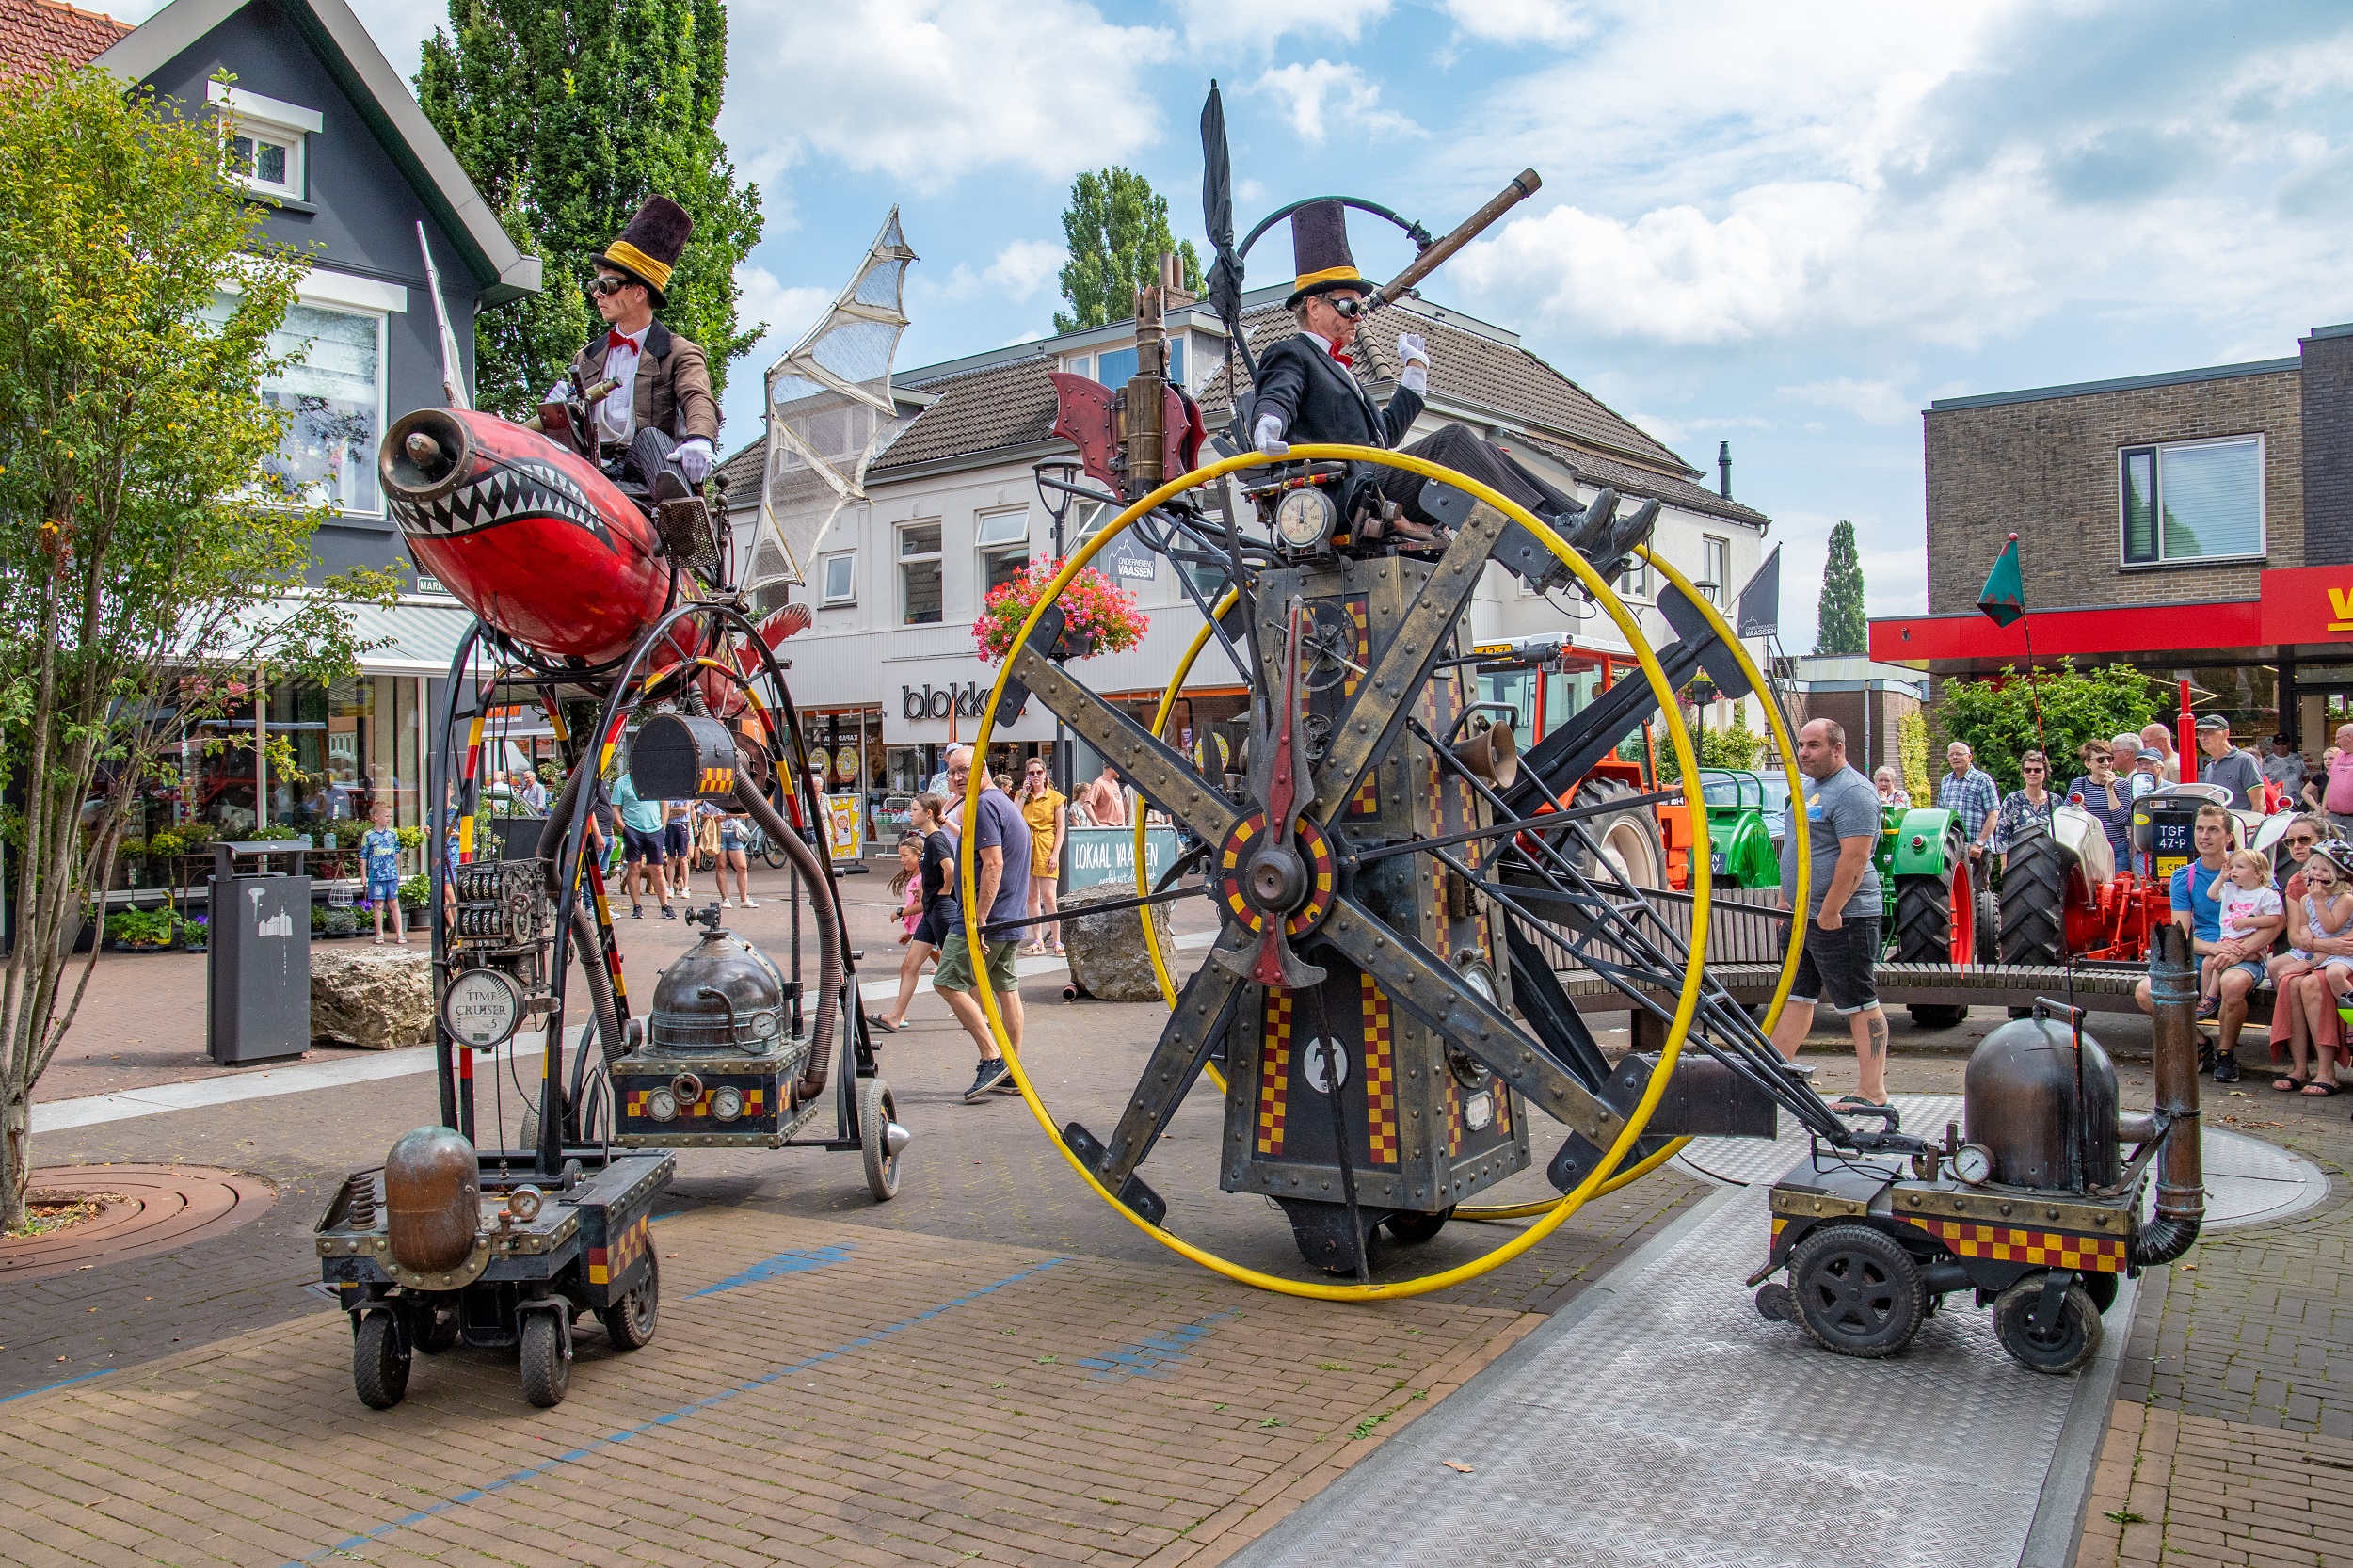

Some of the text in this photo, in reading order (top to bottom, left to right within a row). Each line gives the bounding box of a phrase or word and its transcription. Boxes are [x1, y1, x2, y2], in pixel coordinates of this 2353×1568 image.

[1118, 556, 1155, 568] ONDERNEMEND
[1118, 565, 1154, 579] VAASSEN
[1745, 628, 1777, 637] VAASSEN
[2159, 825, 2185, 837] TGF
[2159, 838, 2186, 849] 47-P
[1075, 842, 1159, 870] LOKAAL VAAEN
[467, 991, 497, 1001] TIME
[456, 1005, 506, 1015] CRUISER
